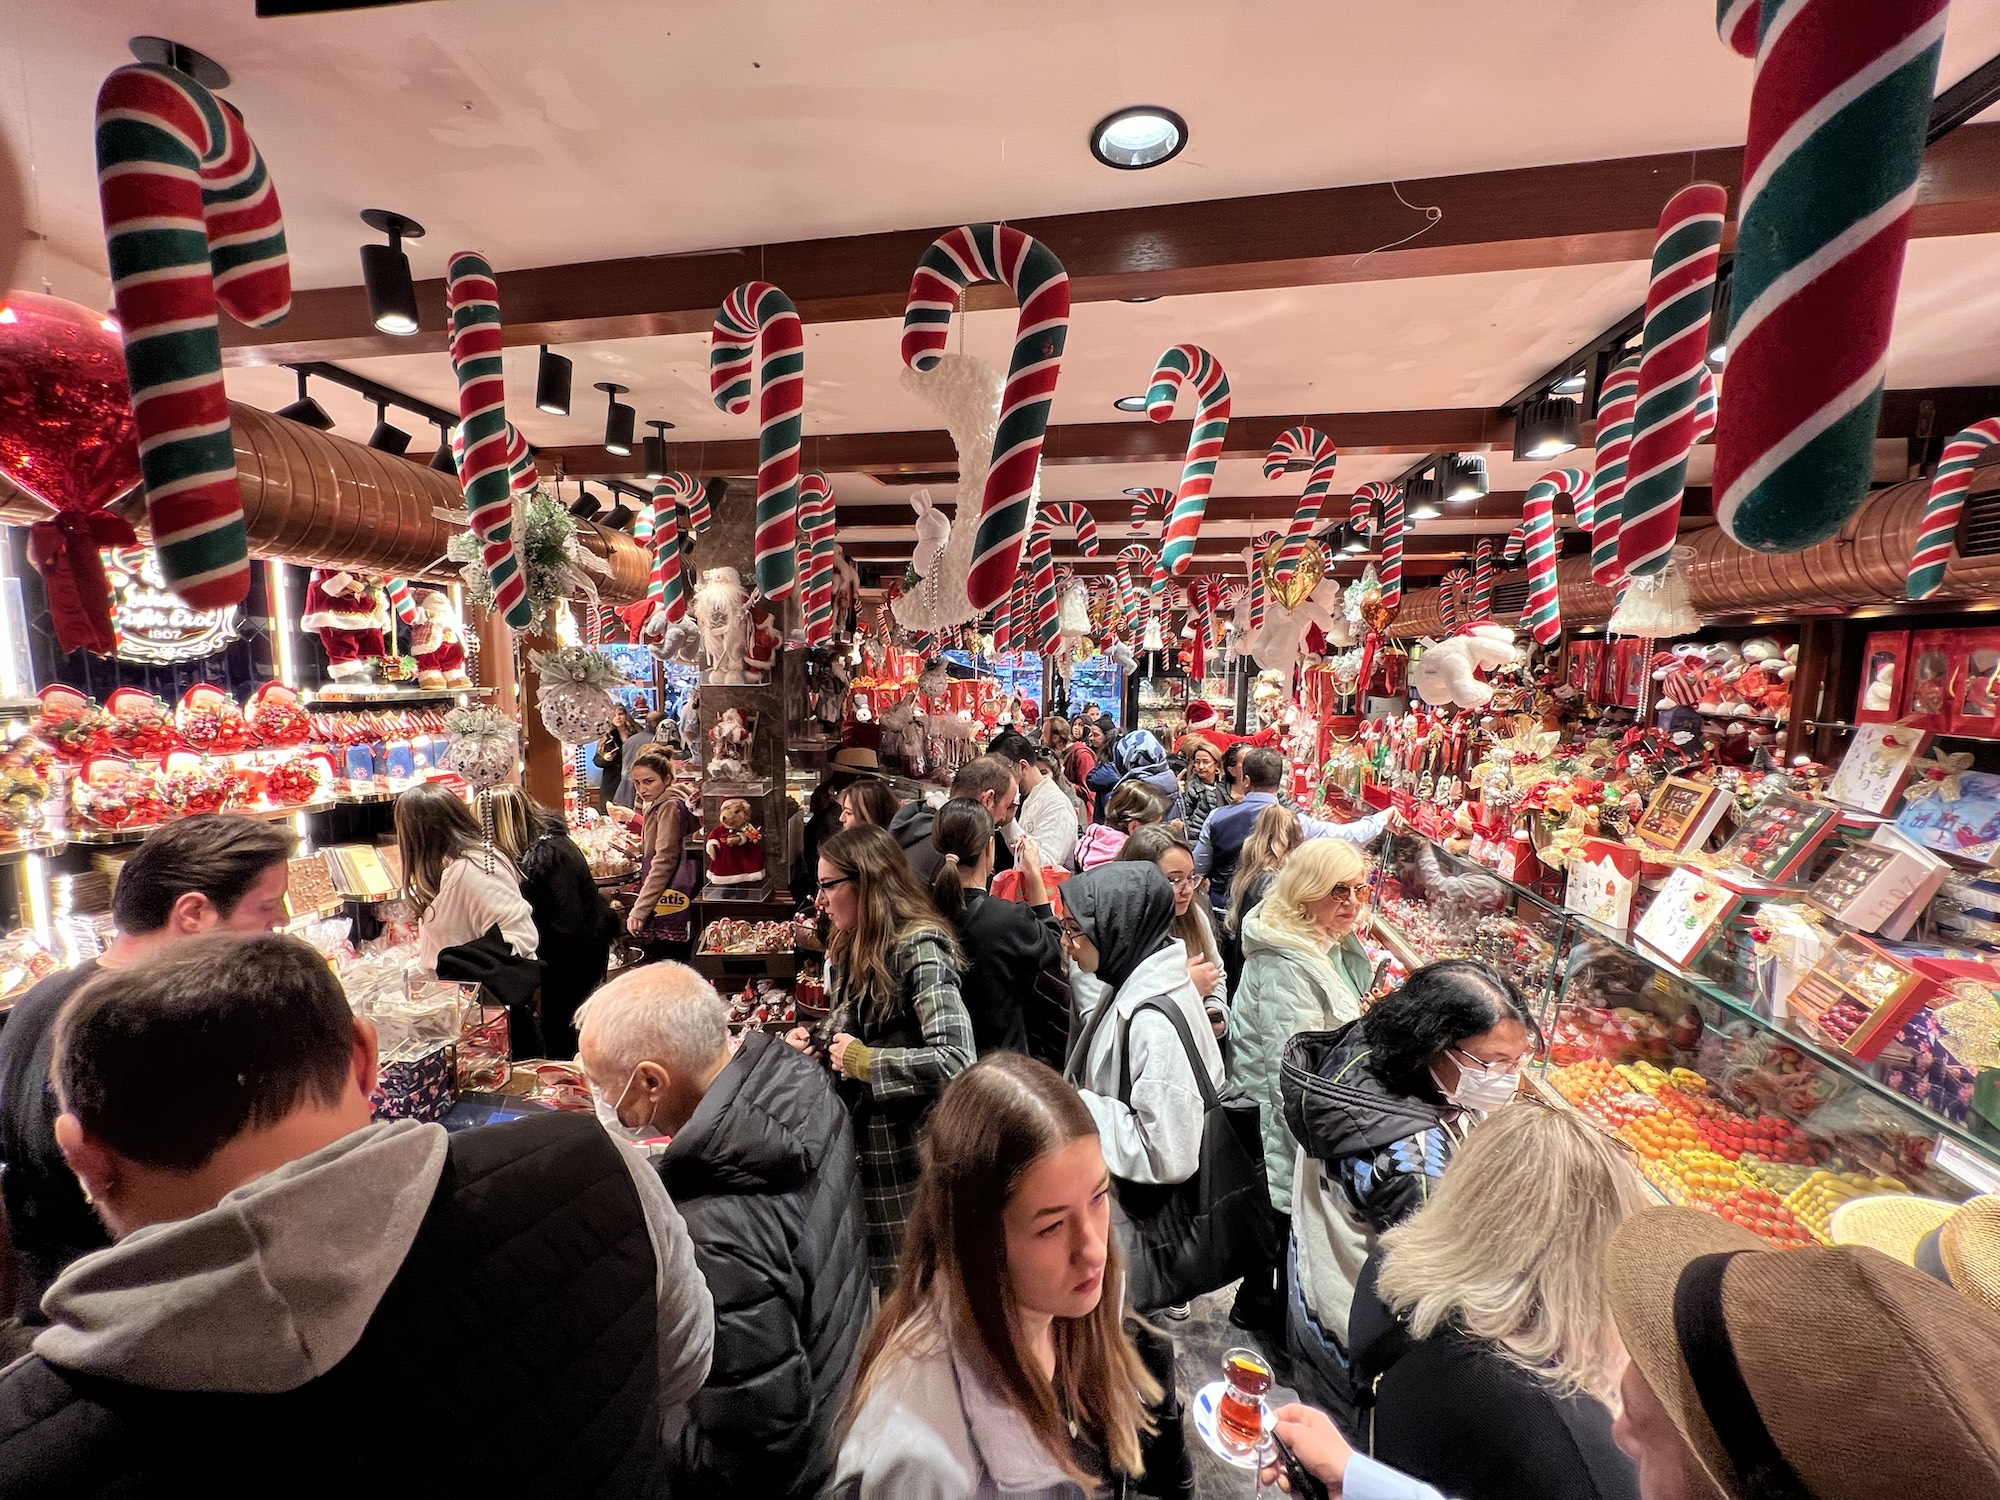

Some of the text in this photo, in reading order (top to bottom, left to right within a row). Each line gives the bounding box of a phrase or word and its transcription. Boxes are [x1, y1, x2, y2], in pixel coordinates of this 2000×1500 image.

[169, 608, 216, 627] Erol
[148, 629, 182, 640] 1807
[660, 893, 685, 905] atis
